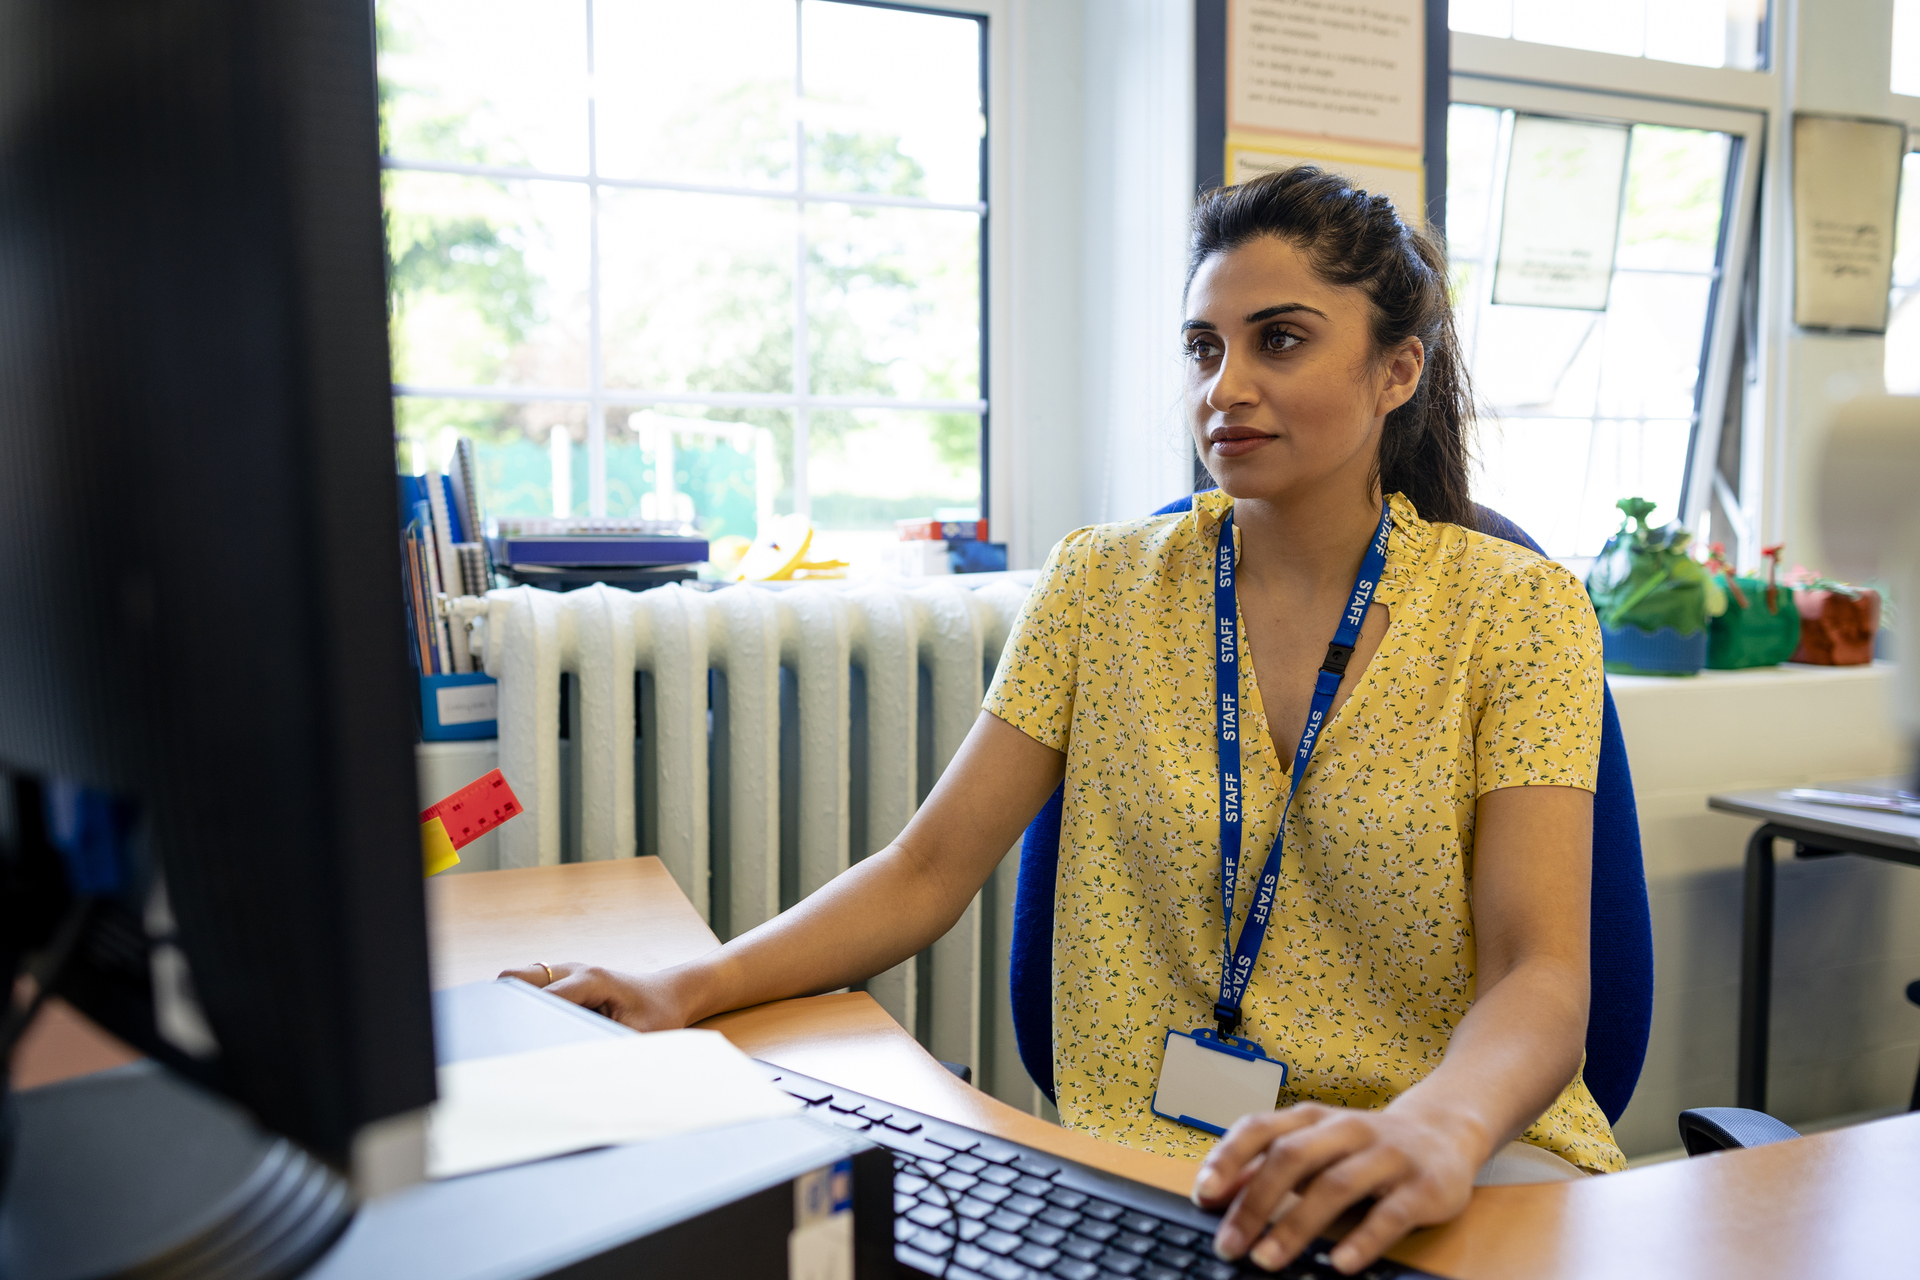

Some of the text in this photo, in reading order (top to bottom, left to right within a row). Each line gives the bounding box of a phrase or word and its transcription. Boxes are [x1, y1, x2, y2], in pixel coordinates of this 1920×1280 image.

[1374, 513, 1392, 557] STAFF
[1219, 545, 1232, 588] STAFF
[1347, 579, 1373, 626] STAFF
[1220, 617, 1234, 663] STAFF
[1222, 693, 1236, 741] STAFF
[1299, 710, 1323, 759] STAFF
[1225, 772, 1238, 823] STAFF
[1225, 857, 1236, 908] STAFF
[1252, 873, 1276, 925] STAFF
